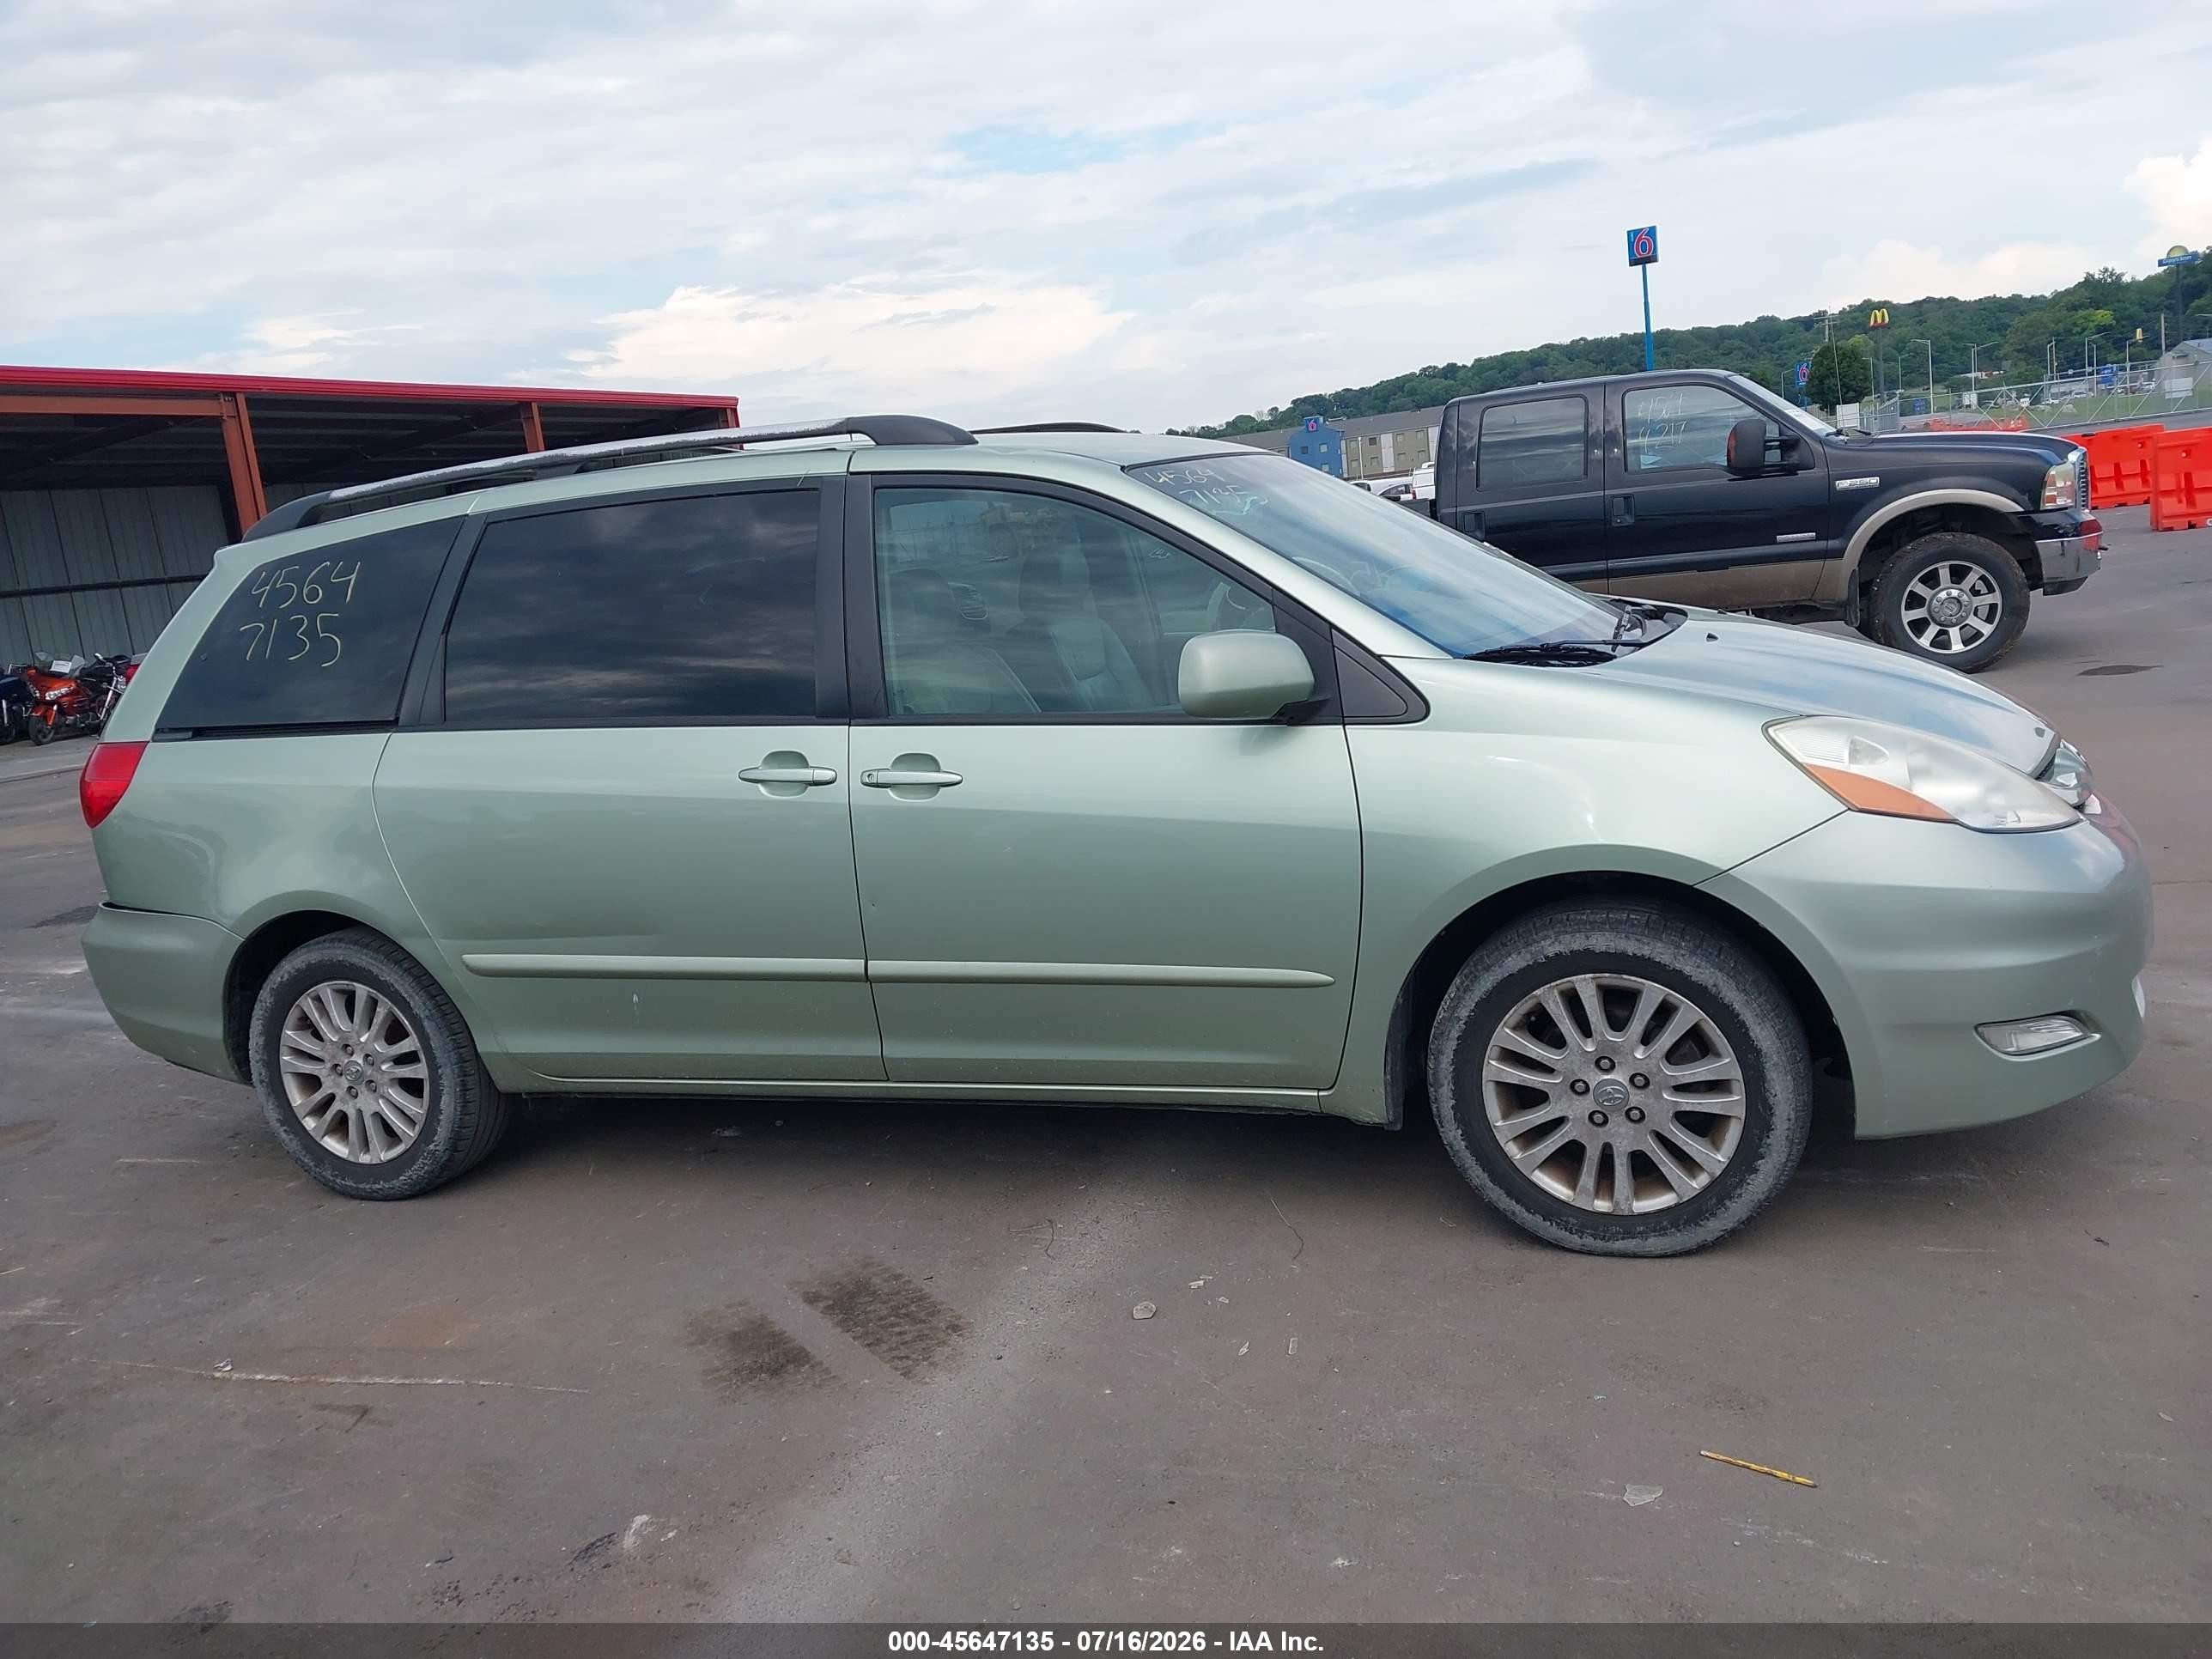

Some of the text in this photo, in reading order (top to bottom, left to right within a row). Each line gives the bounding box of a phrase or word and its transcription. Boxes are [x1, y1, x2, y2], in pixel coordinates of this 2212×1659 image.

[1634, 227, 1654, 258] 6
[1799, 362, 1809, 382] 6
[1144, 469, 1226, 486] 4564
[251, 561, 361, 609] 4564
[240, 613, 342, 667] 7135
